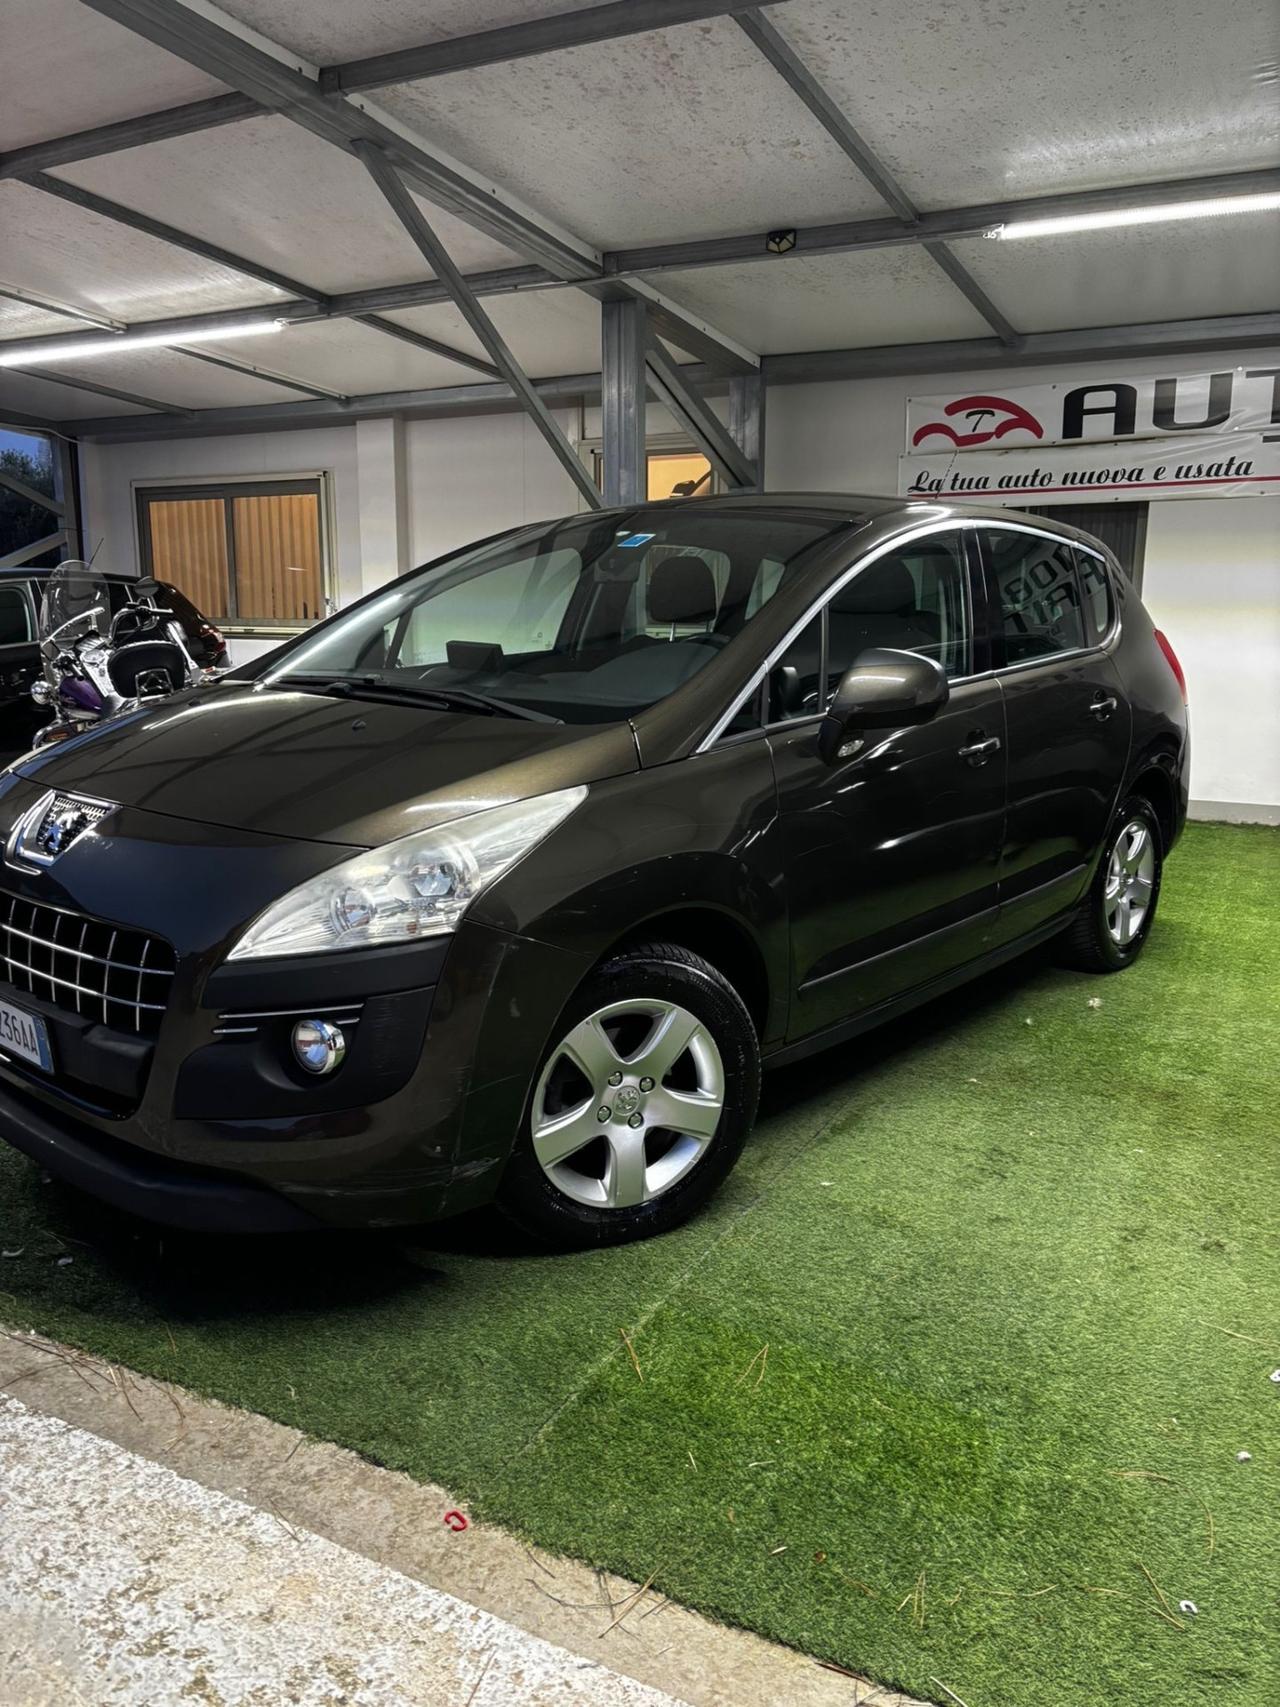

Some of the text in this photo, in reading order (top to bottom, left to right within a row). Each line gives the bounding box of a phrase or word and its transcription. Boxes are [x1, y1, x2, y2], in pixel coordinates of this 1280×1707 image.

[908, 456, 1254, 493] La tua auto nuova e usata
